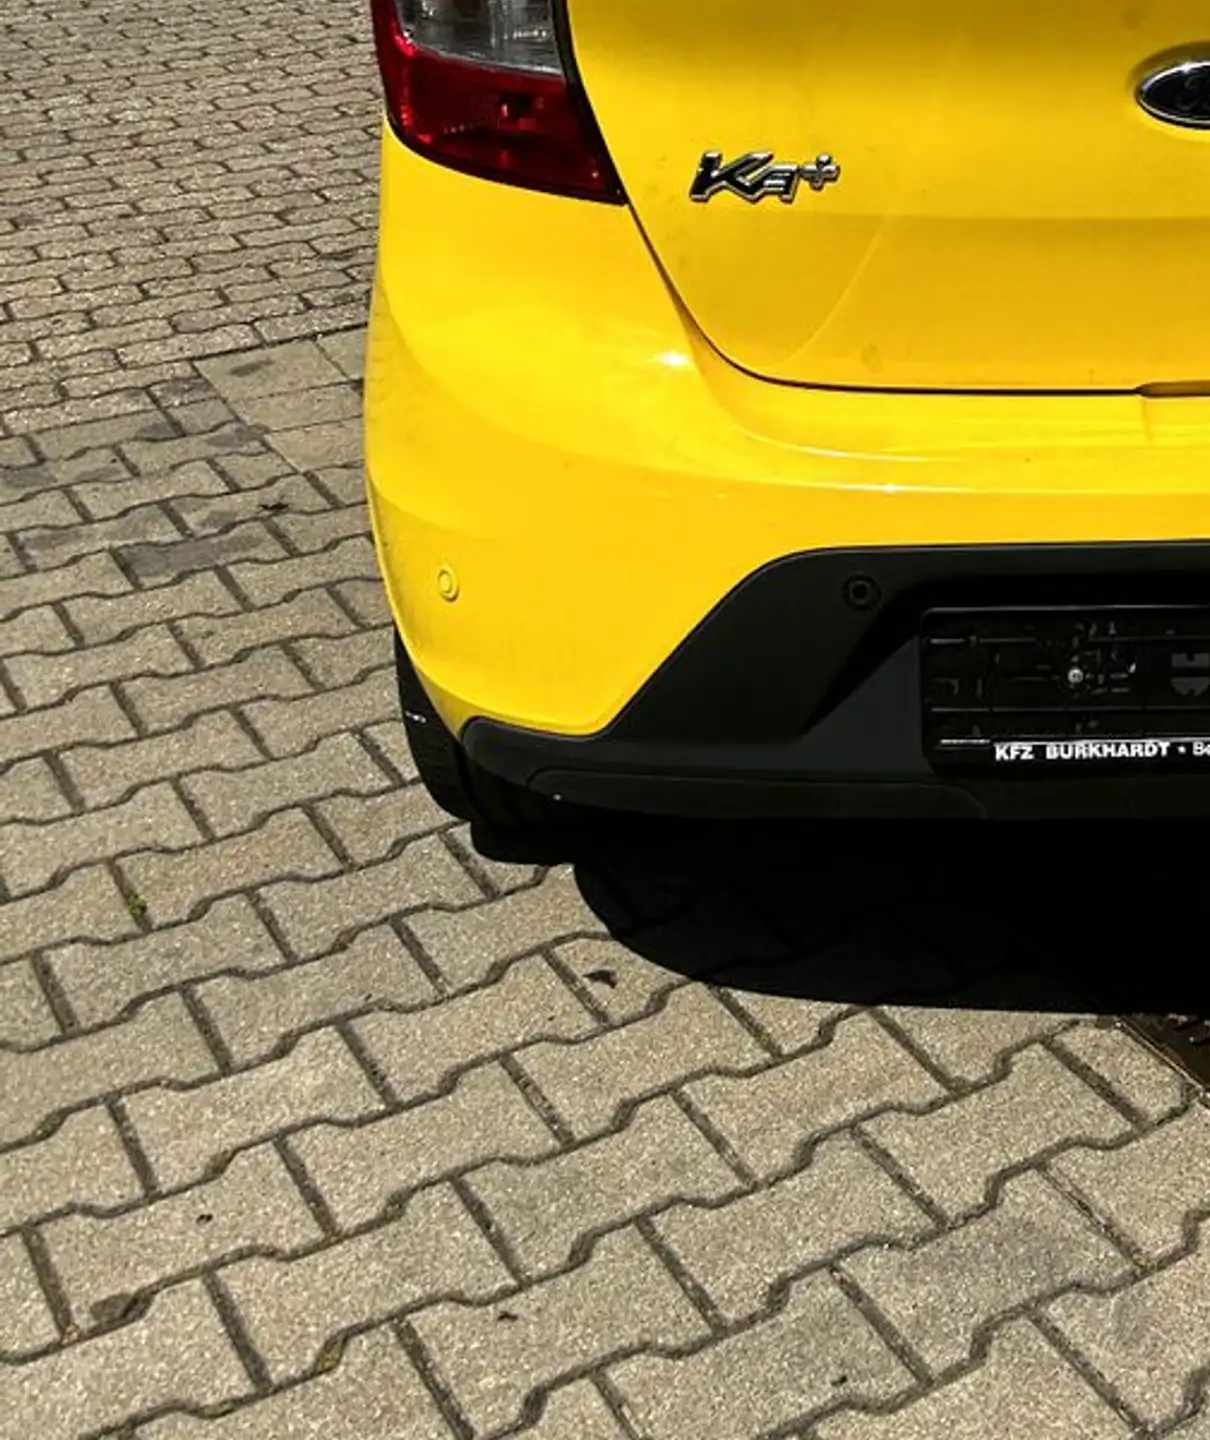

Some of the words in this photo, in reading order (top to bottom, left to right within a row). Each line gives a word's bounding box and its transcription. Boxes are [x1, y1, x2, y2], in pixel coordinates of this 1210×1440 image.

[689, 150, 841, 204] Ka+
[994, 743, 1035, 760] KFZ
[1045, 741, 1171, 759] BURKHARDT
